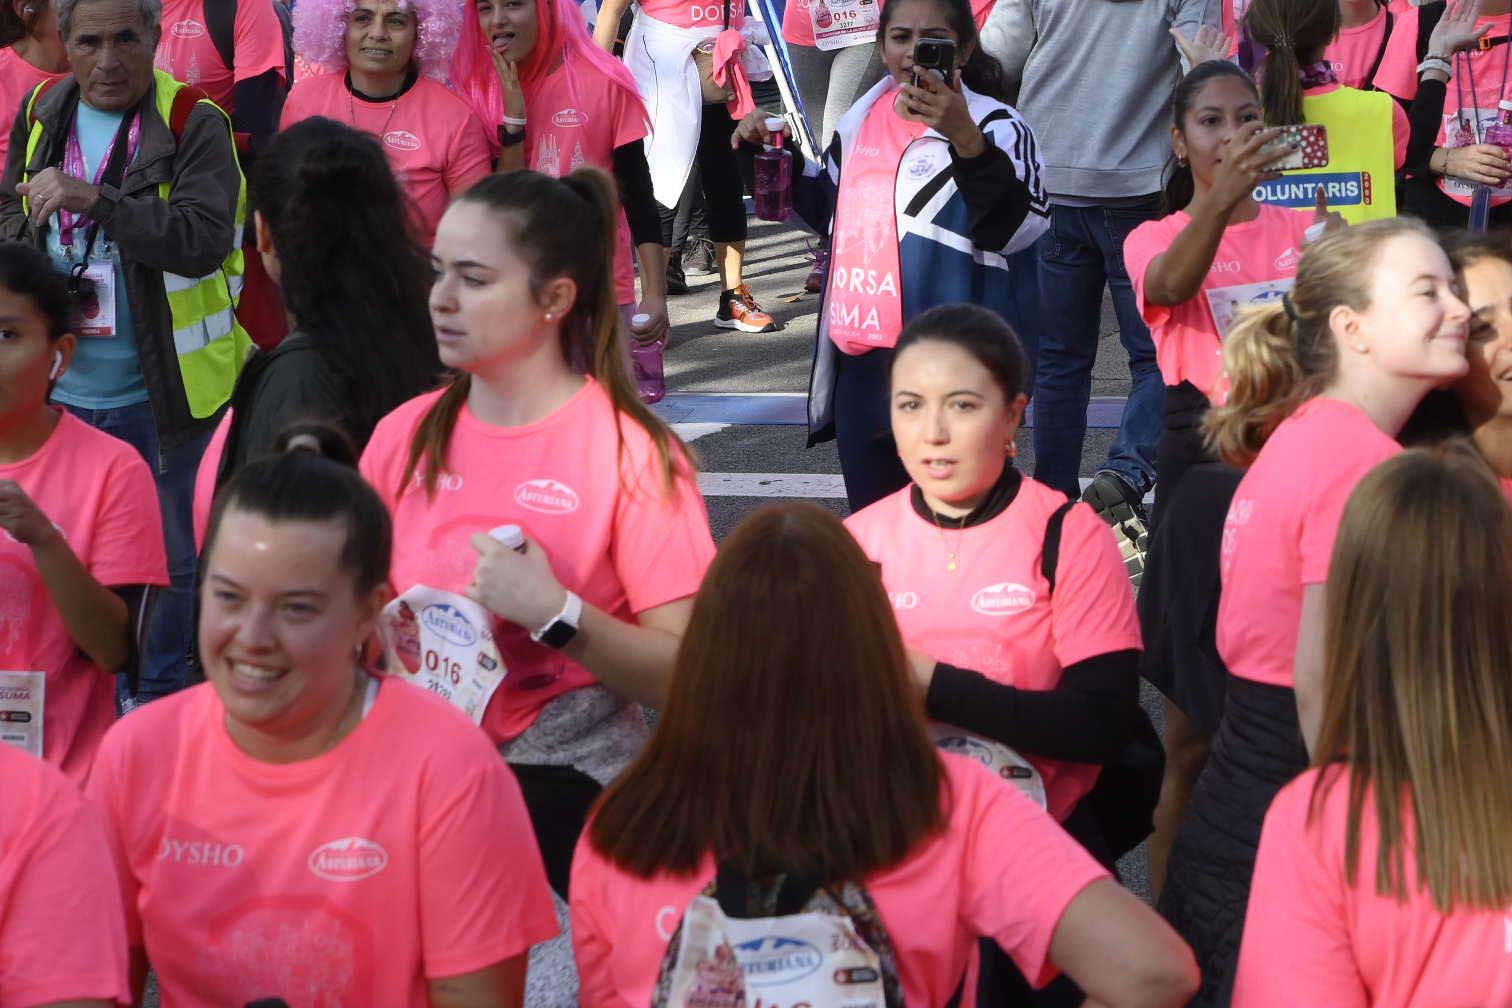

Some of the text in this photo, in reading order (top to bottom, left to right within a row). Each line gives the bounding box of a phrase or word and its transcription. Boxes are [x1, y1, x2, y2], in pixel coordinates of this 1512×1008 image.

[691, 4, 745, 22] DOSA
[833, 10, 857, 22] 016
[1252, 180, 1359, 202] OLUNTARIS
[1210, 260, 1241, 273] SHO
[833, 265, 897, 297] ORSA
[830, 302, 881, 331] SUMA
[415, 470, 465, 491] YHO
[425, 649, 463, 685] 016
